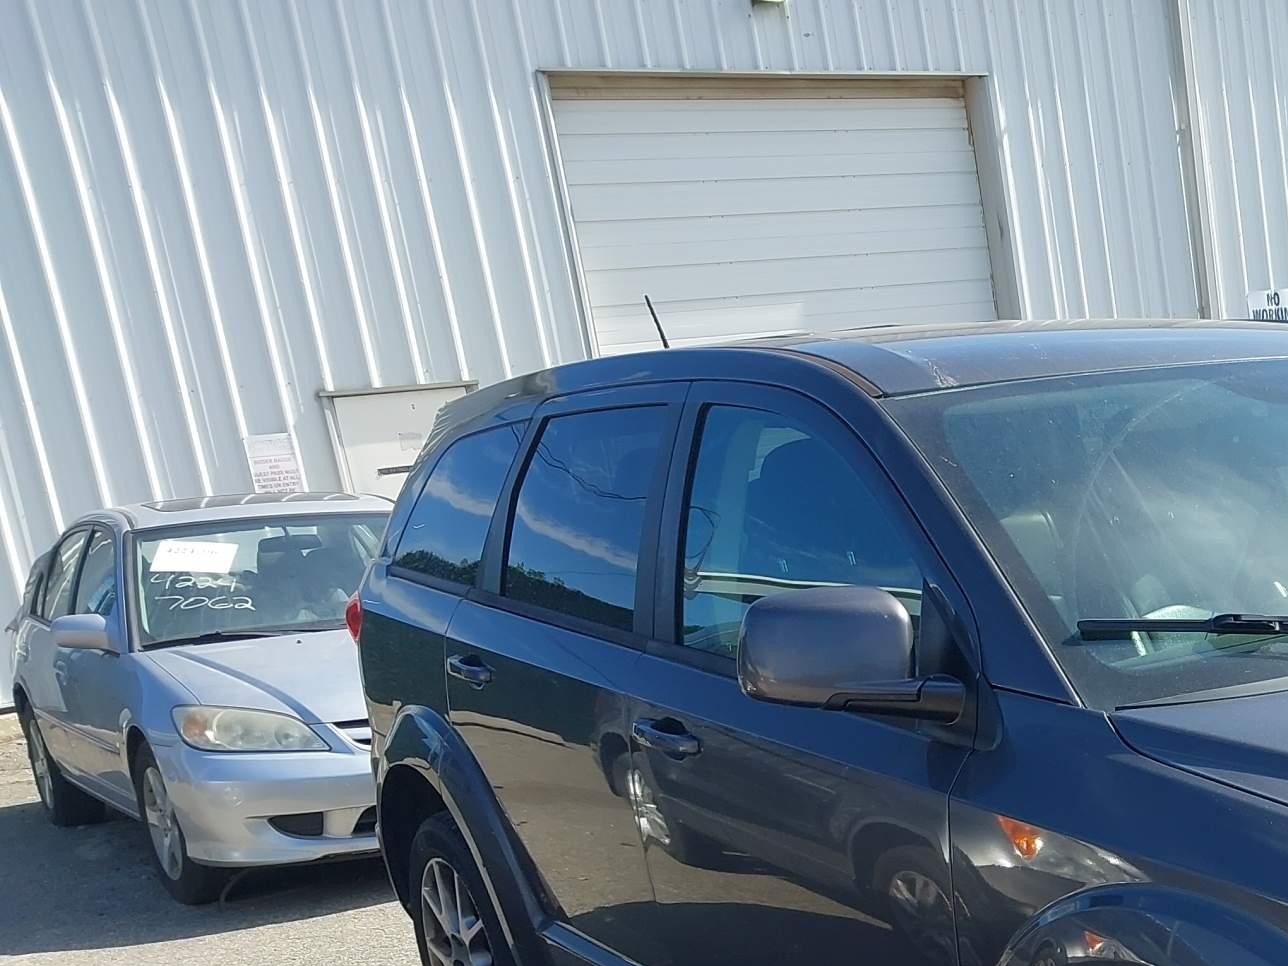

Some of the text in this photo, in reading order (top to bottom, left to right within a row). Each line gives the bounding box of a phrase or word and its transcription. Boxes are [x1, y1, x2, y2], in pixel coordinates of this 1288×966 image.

[1266, 291, 1280, 307] NO
[151, 573, 240, 592] 4224
[155, 596, 256, 610] 7062
